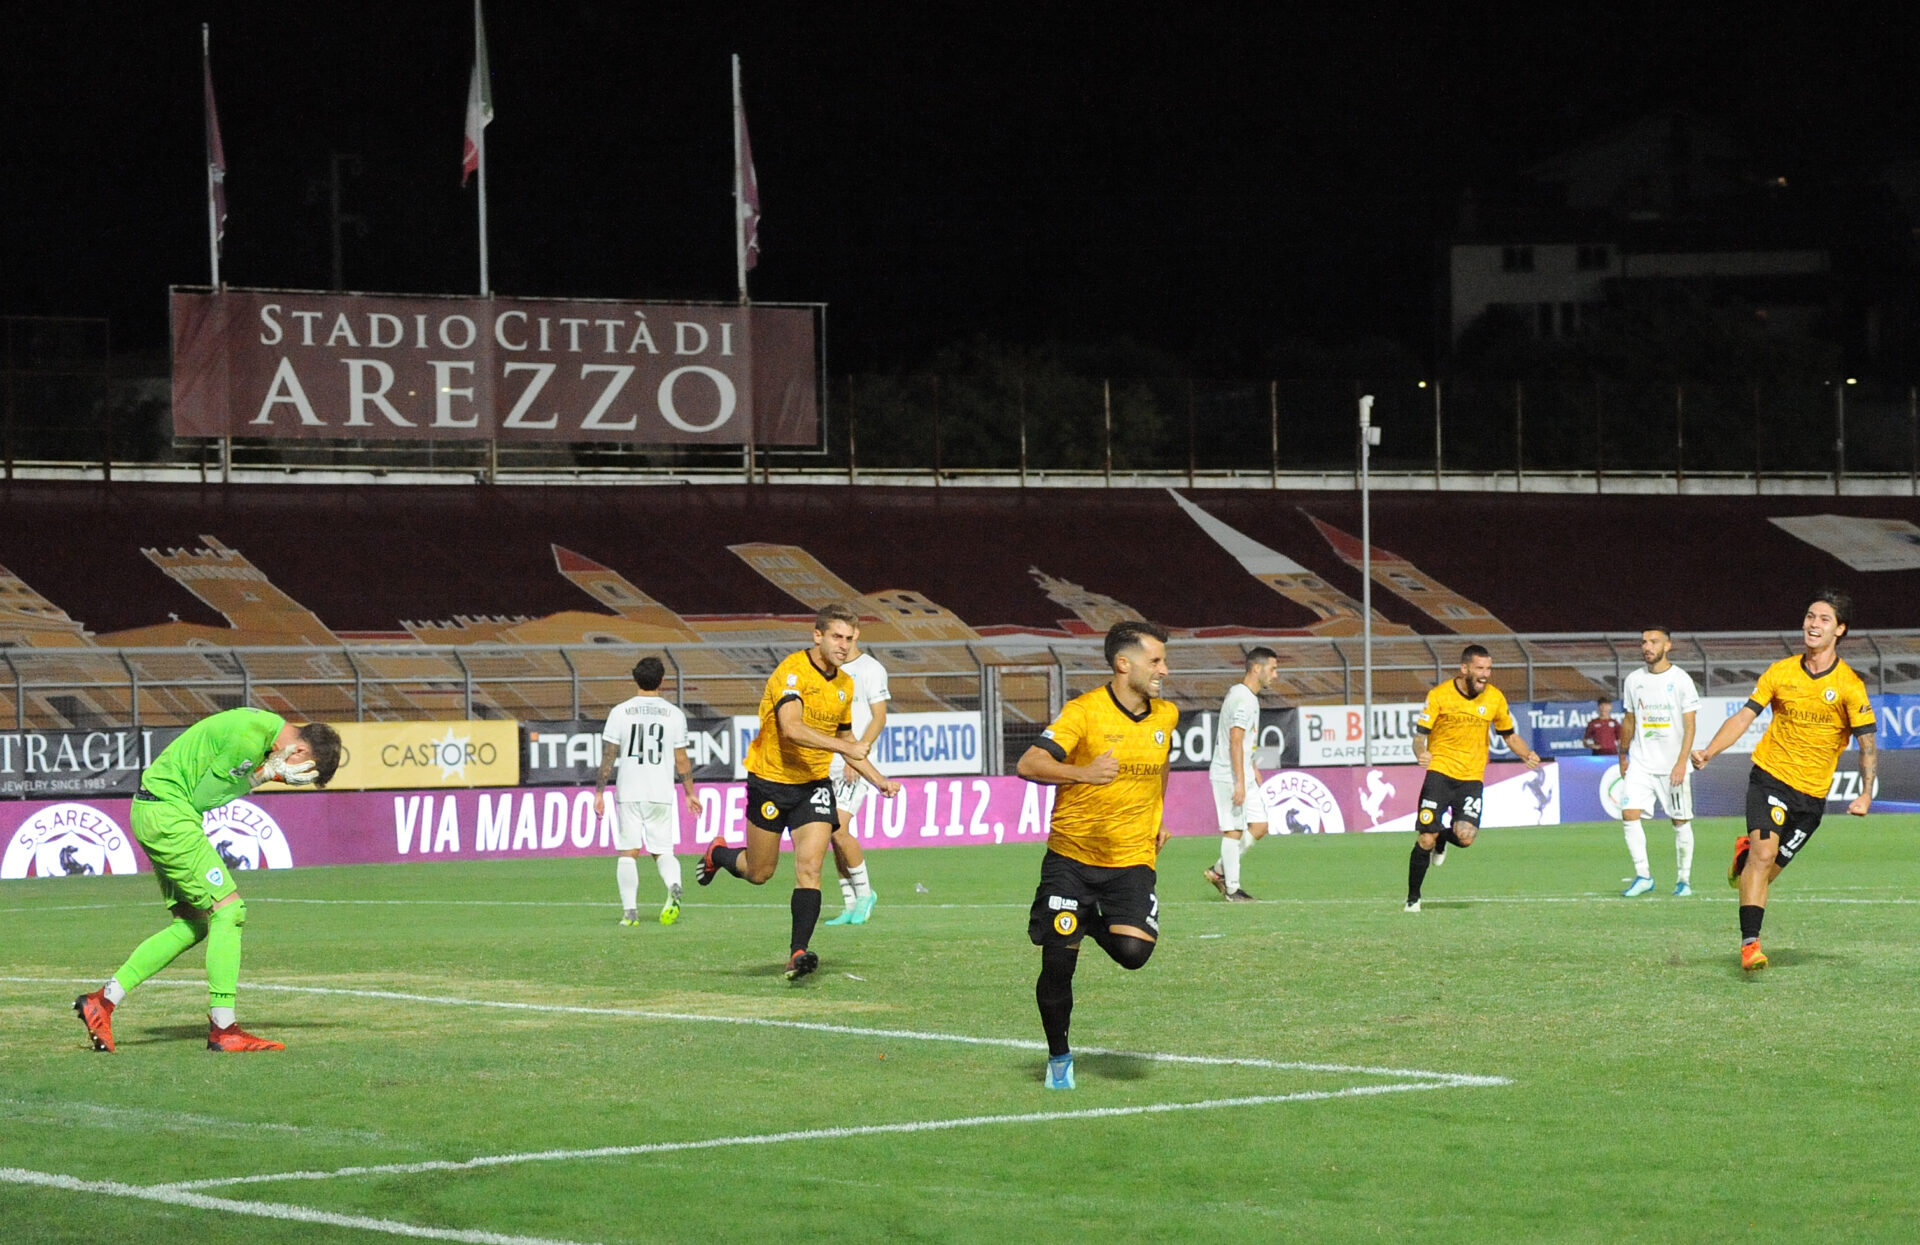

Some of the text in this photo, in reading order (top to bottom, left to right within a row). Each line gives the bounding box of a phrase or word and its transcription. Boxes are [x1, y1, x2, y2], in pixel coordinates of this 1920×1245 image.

[675, 320, 734, 357] DI
[249, 355, 738, 434] AREZZO
[1528, 710, 1564, 728] Tizzi
[381, 742, 497, 768] CASTORO
[627, 723, 664, 765] 43
[877, 724, 976, 764] MERCATO
[1, 780, 48, 793] JEWELRY
[50, 778, 80, 791] SINCE
[810, 787, 831, 806] 28
[394, 795, 460, 855] VIA
[920, 779, 1004, 844] 112,
[1463, 796, 1481, 813] 24
